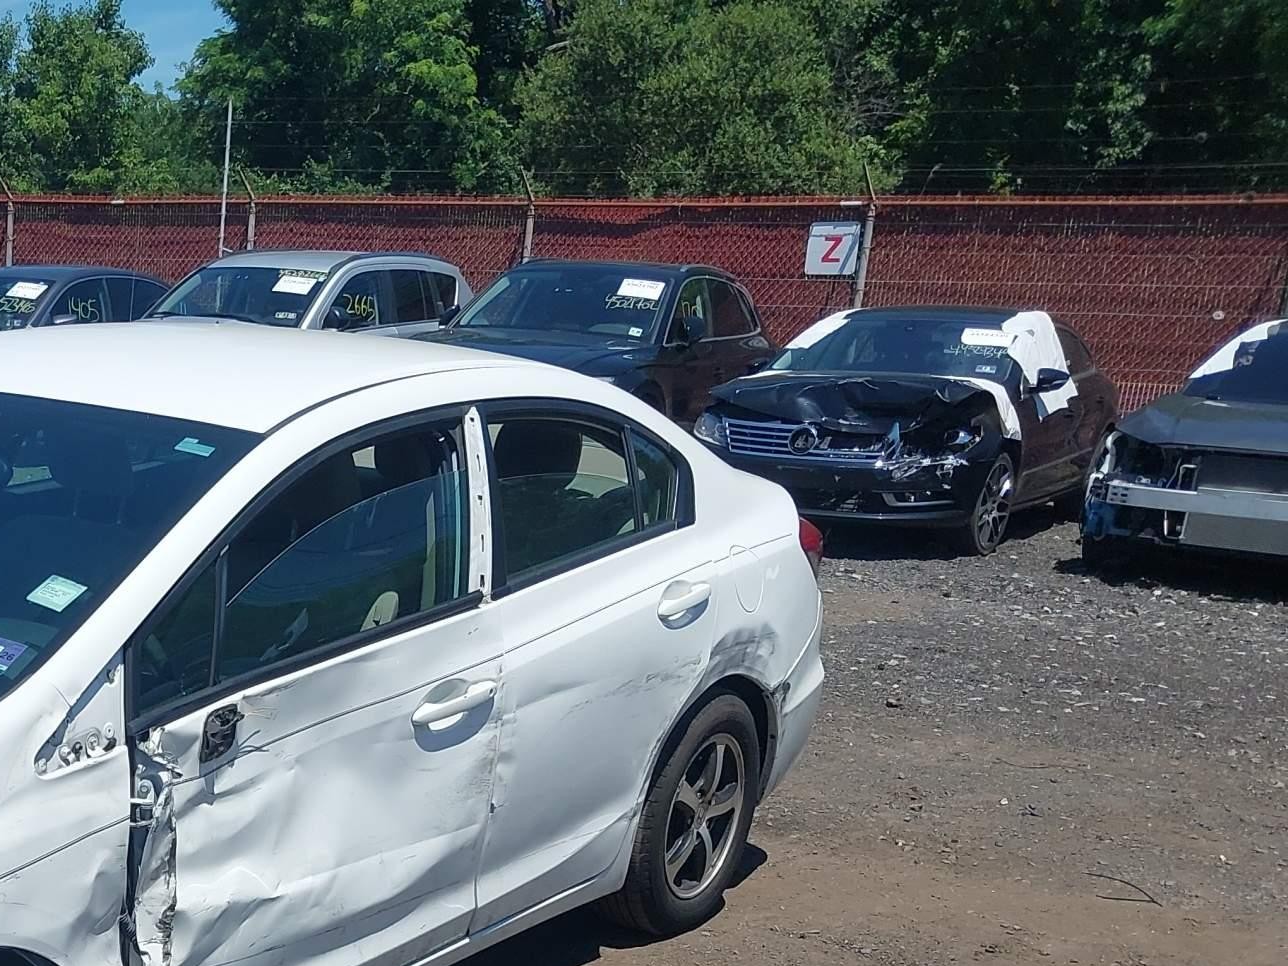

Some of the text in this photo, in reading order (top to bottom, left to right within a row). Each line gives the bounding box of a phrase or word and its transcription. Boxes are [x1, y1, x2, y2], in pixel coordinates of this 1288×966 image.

[821, 235, 843, 263] Z
[68, 296, 100, 322] 1405
[342, 293, 376, 322] 2665
[0, 651, 15, 662] 26
